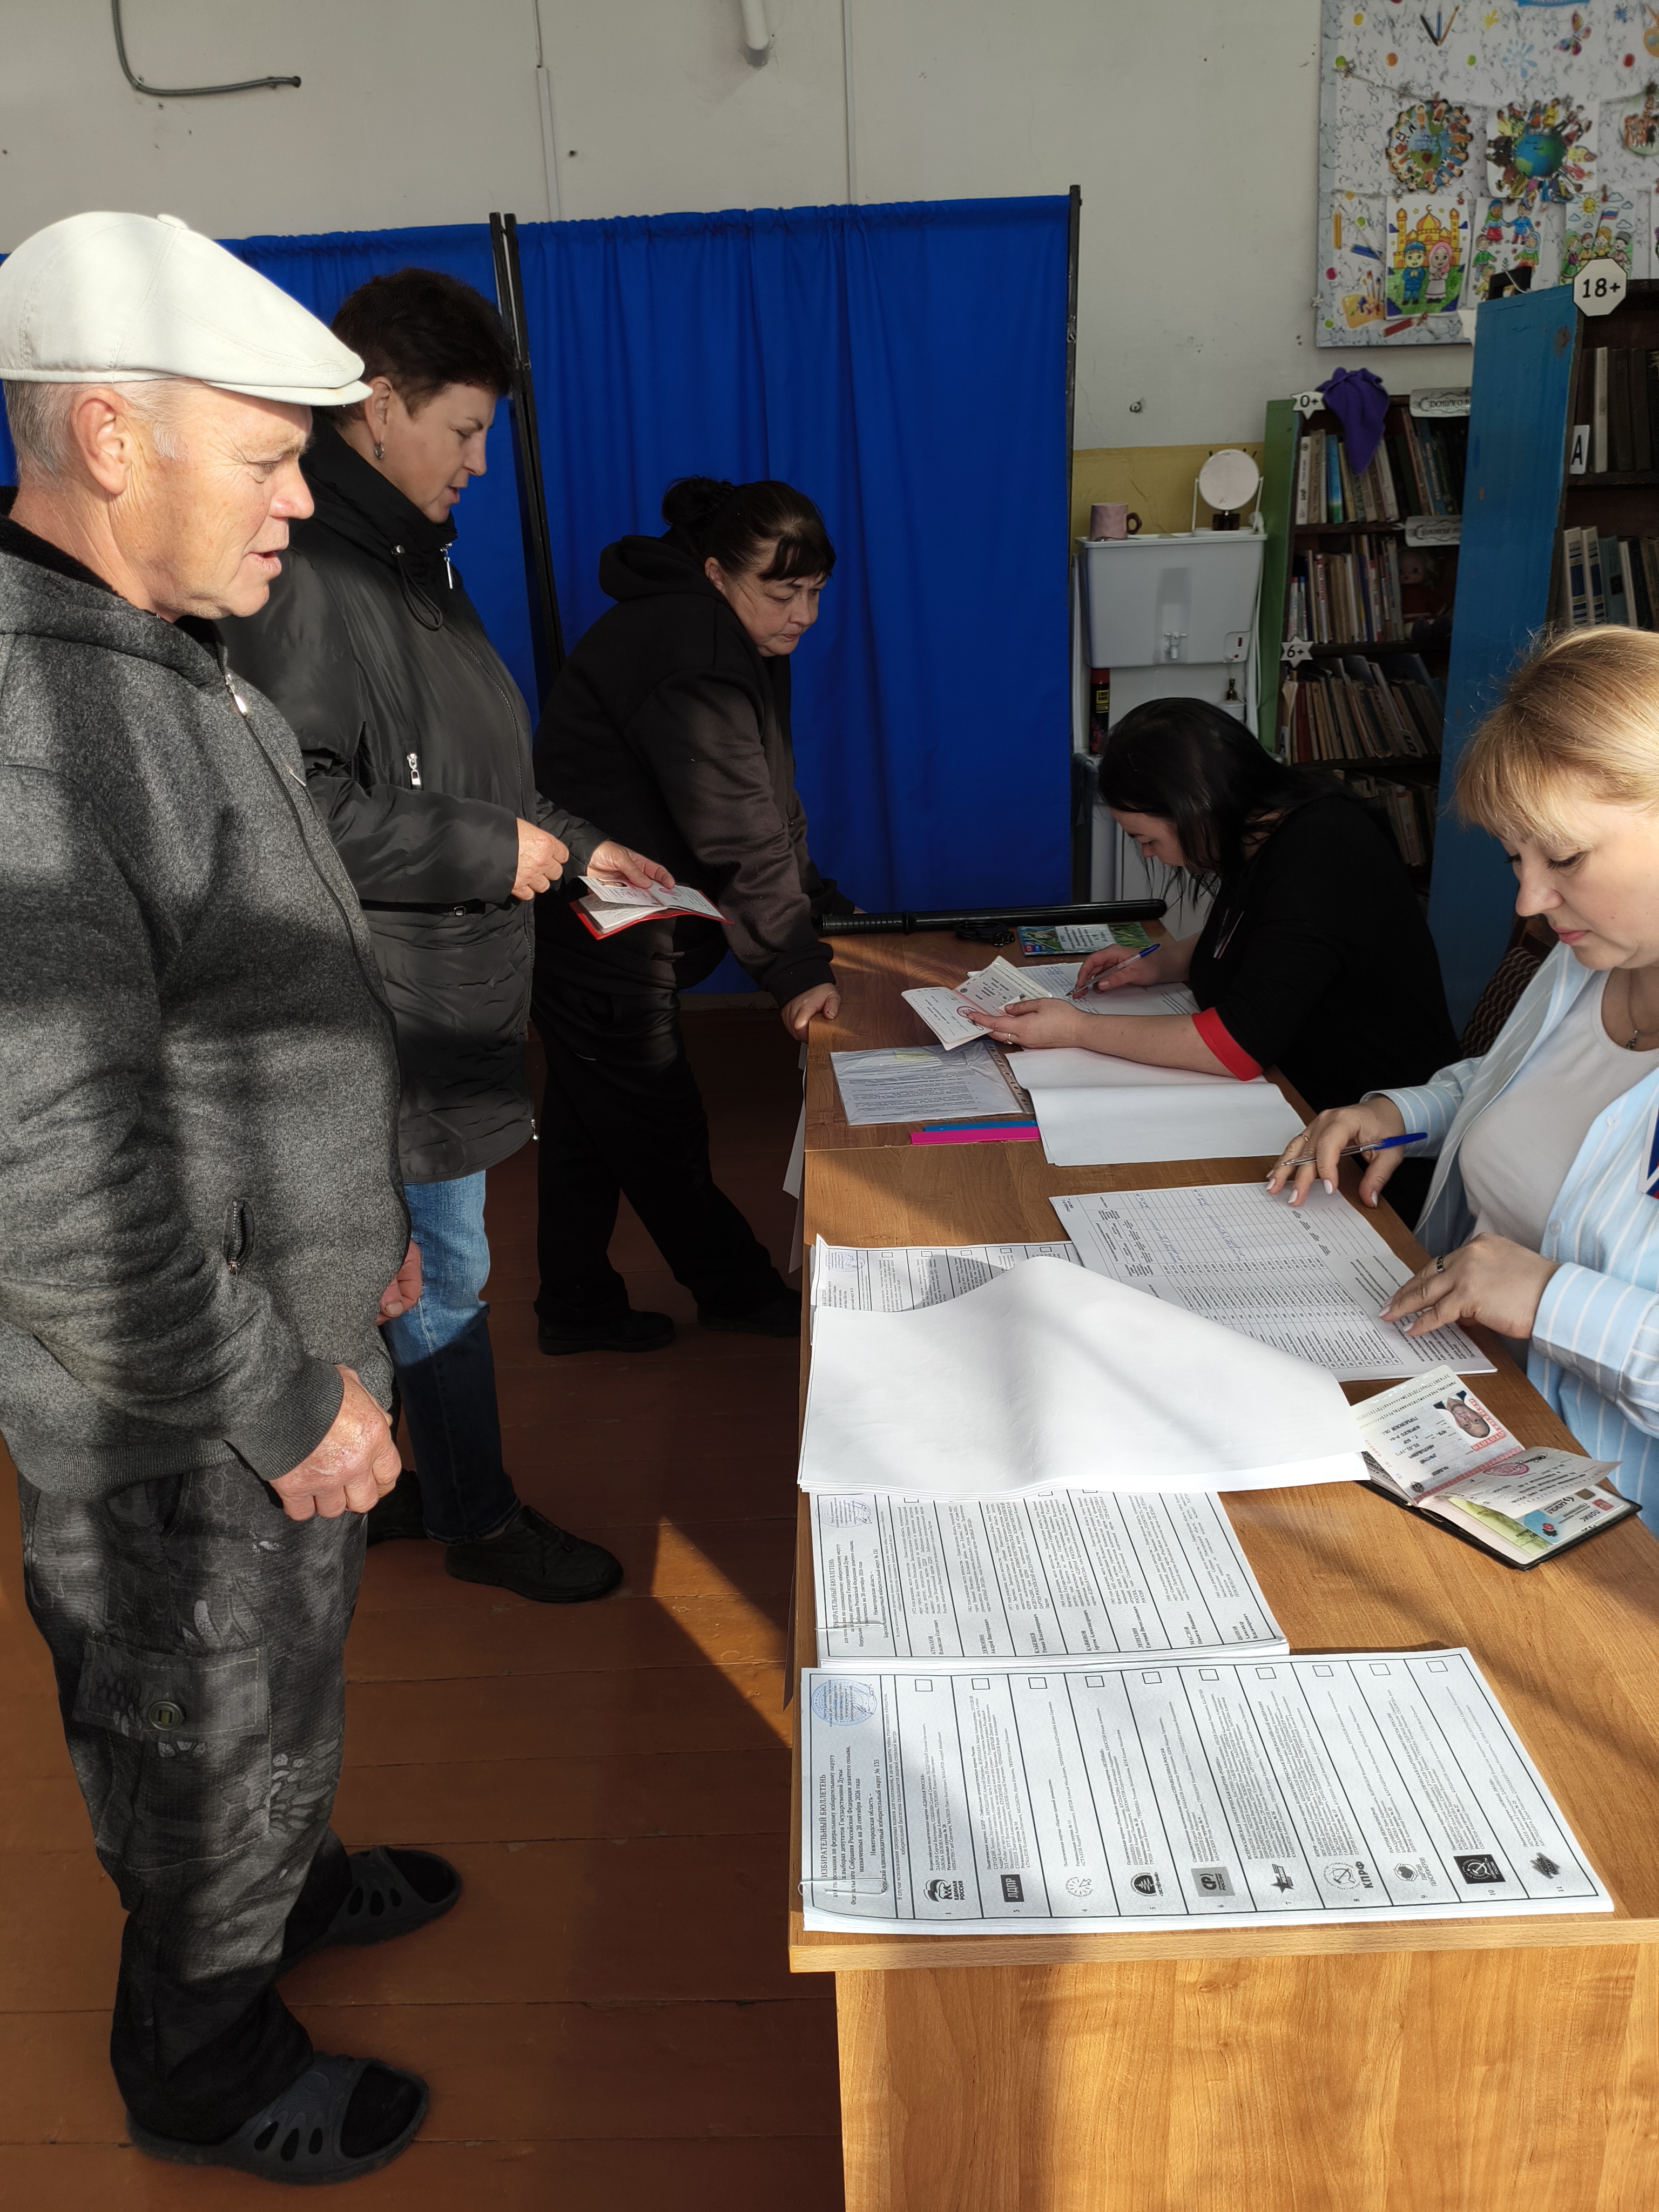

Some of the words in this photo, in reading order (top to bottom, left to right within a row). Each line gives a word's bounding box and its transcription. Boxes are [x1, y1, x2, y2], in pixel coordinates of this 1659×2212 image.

[1582, 278, 1621, 298] 18+
[1300, 395, 1319, 408] 0+
[1287, 645, 1305, 658] 6+
[1579, 1509, 1601, 1522] ПОЛИС
[837, 1784, 845, 1825] Государственной
[875, 1789, 884, 1827] избирательный
[818, 1817, 828, 1877] ИЗБИРАТЕЛЬНЫЙ
[877, 1828, 886, 1869] одномандатный
[1217, 1873, 1226, 1890] РОССИЯ
[1355, 1861, 1373, 1889] КПРФ
[1415, 1864, 1427, 1880] ПАРТИЯ
[1419, 1857, 1437, 1886] ПЕНСИОНЕРОВ
[1005, 1878, 1019, 1898] ЛДПР
